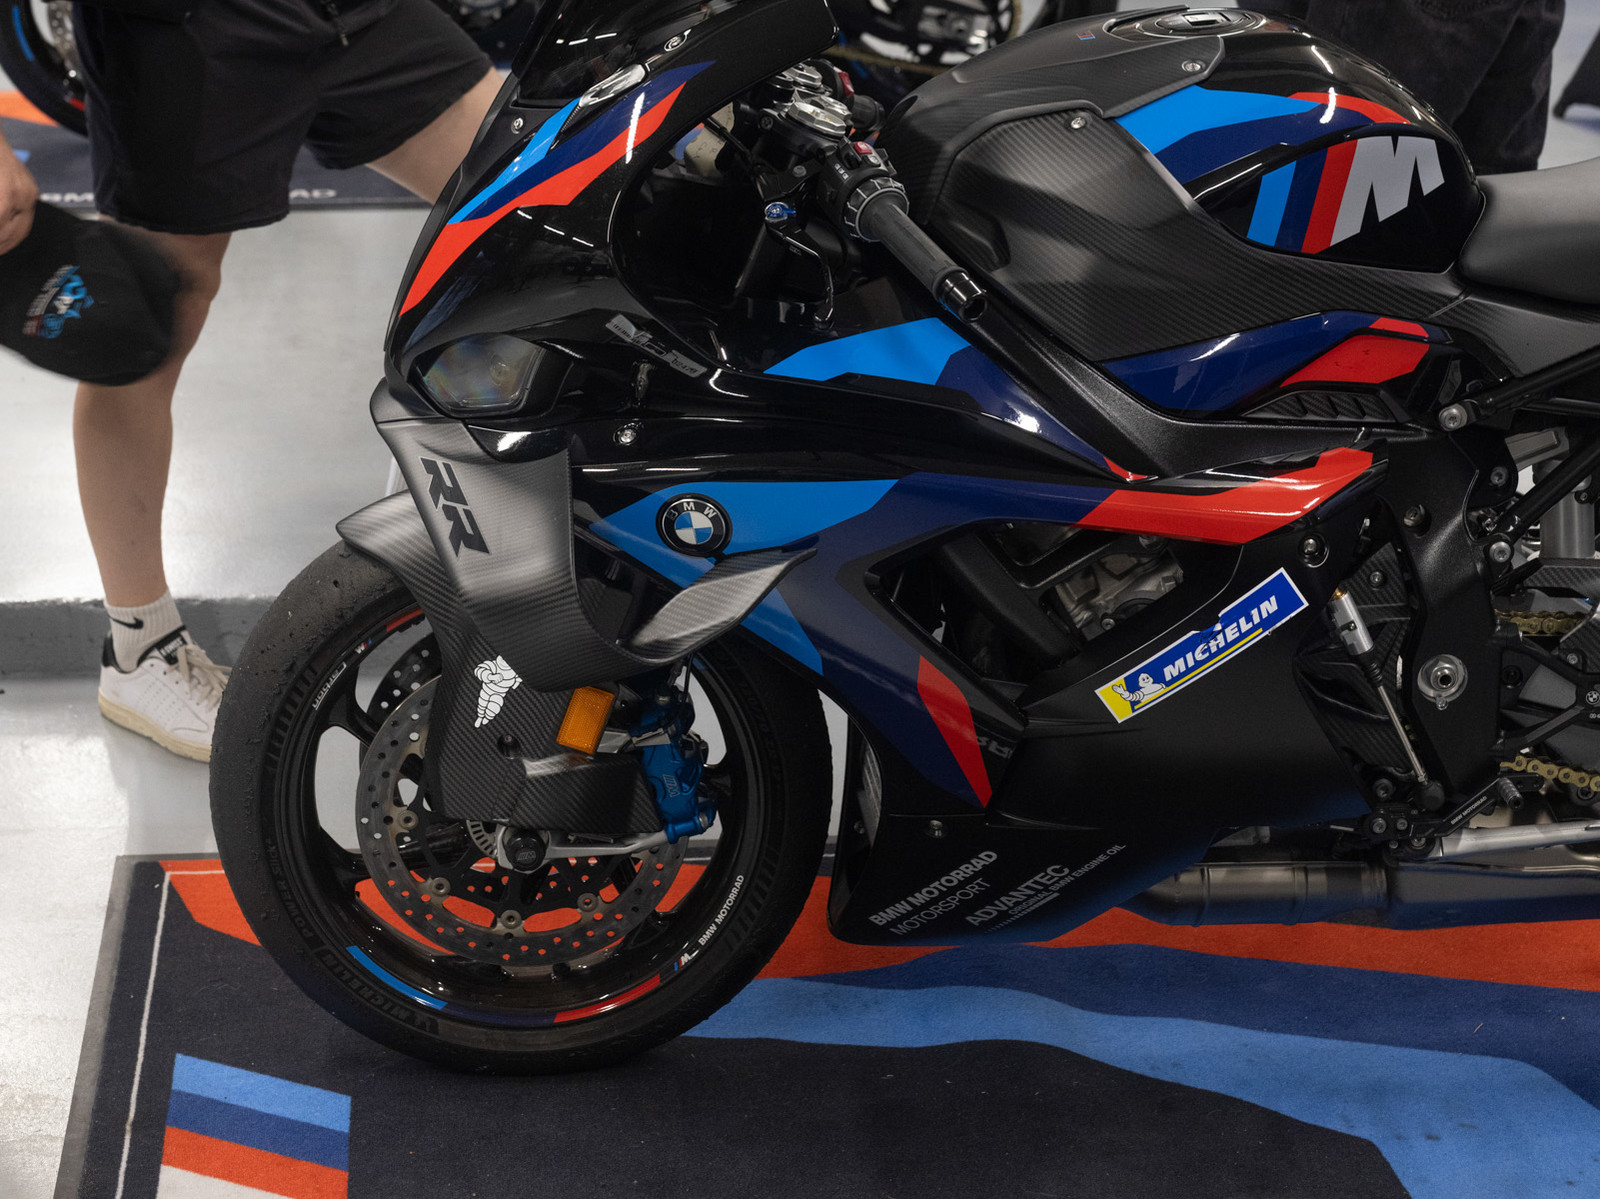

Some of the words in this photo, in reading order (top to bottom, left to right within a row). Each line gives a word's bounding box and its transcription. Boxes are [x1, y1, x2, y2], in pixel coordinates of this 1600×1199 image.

[420, 457, 490, 558] RR
[667, 501, 717, 520] BMW
[1163, 595, 1278, 682] MICHELIN
[698, 923, 718, 946] BMW
[714, 875, 744, 925] MOTORRAD
[868, 899, 913, 926] BMW
[906, 850, 998, 907] MOTORRAD
[889, 877, 992, 936] MOTORSPORT
[965, 864, 1070, 926] ADVANTEC
[1008, 889, 1051, 916] ORIGINAL
[1050, 874, 1075, 892] BMW
[1073, 853, 1110, 878] ENGINE
[1106, 844, 1127, 857] OIL
